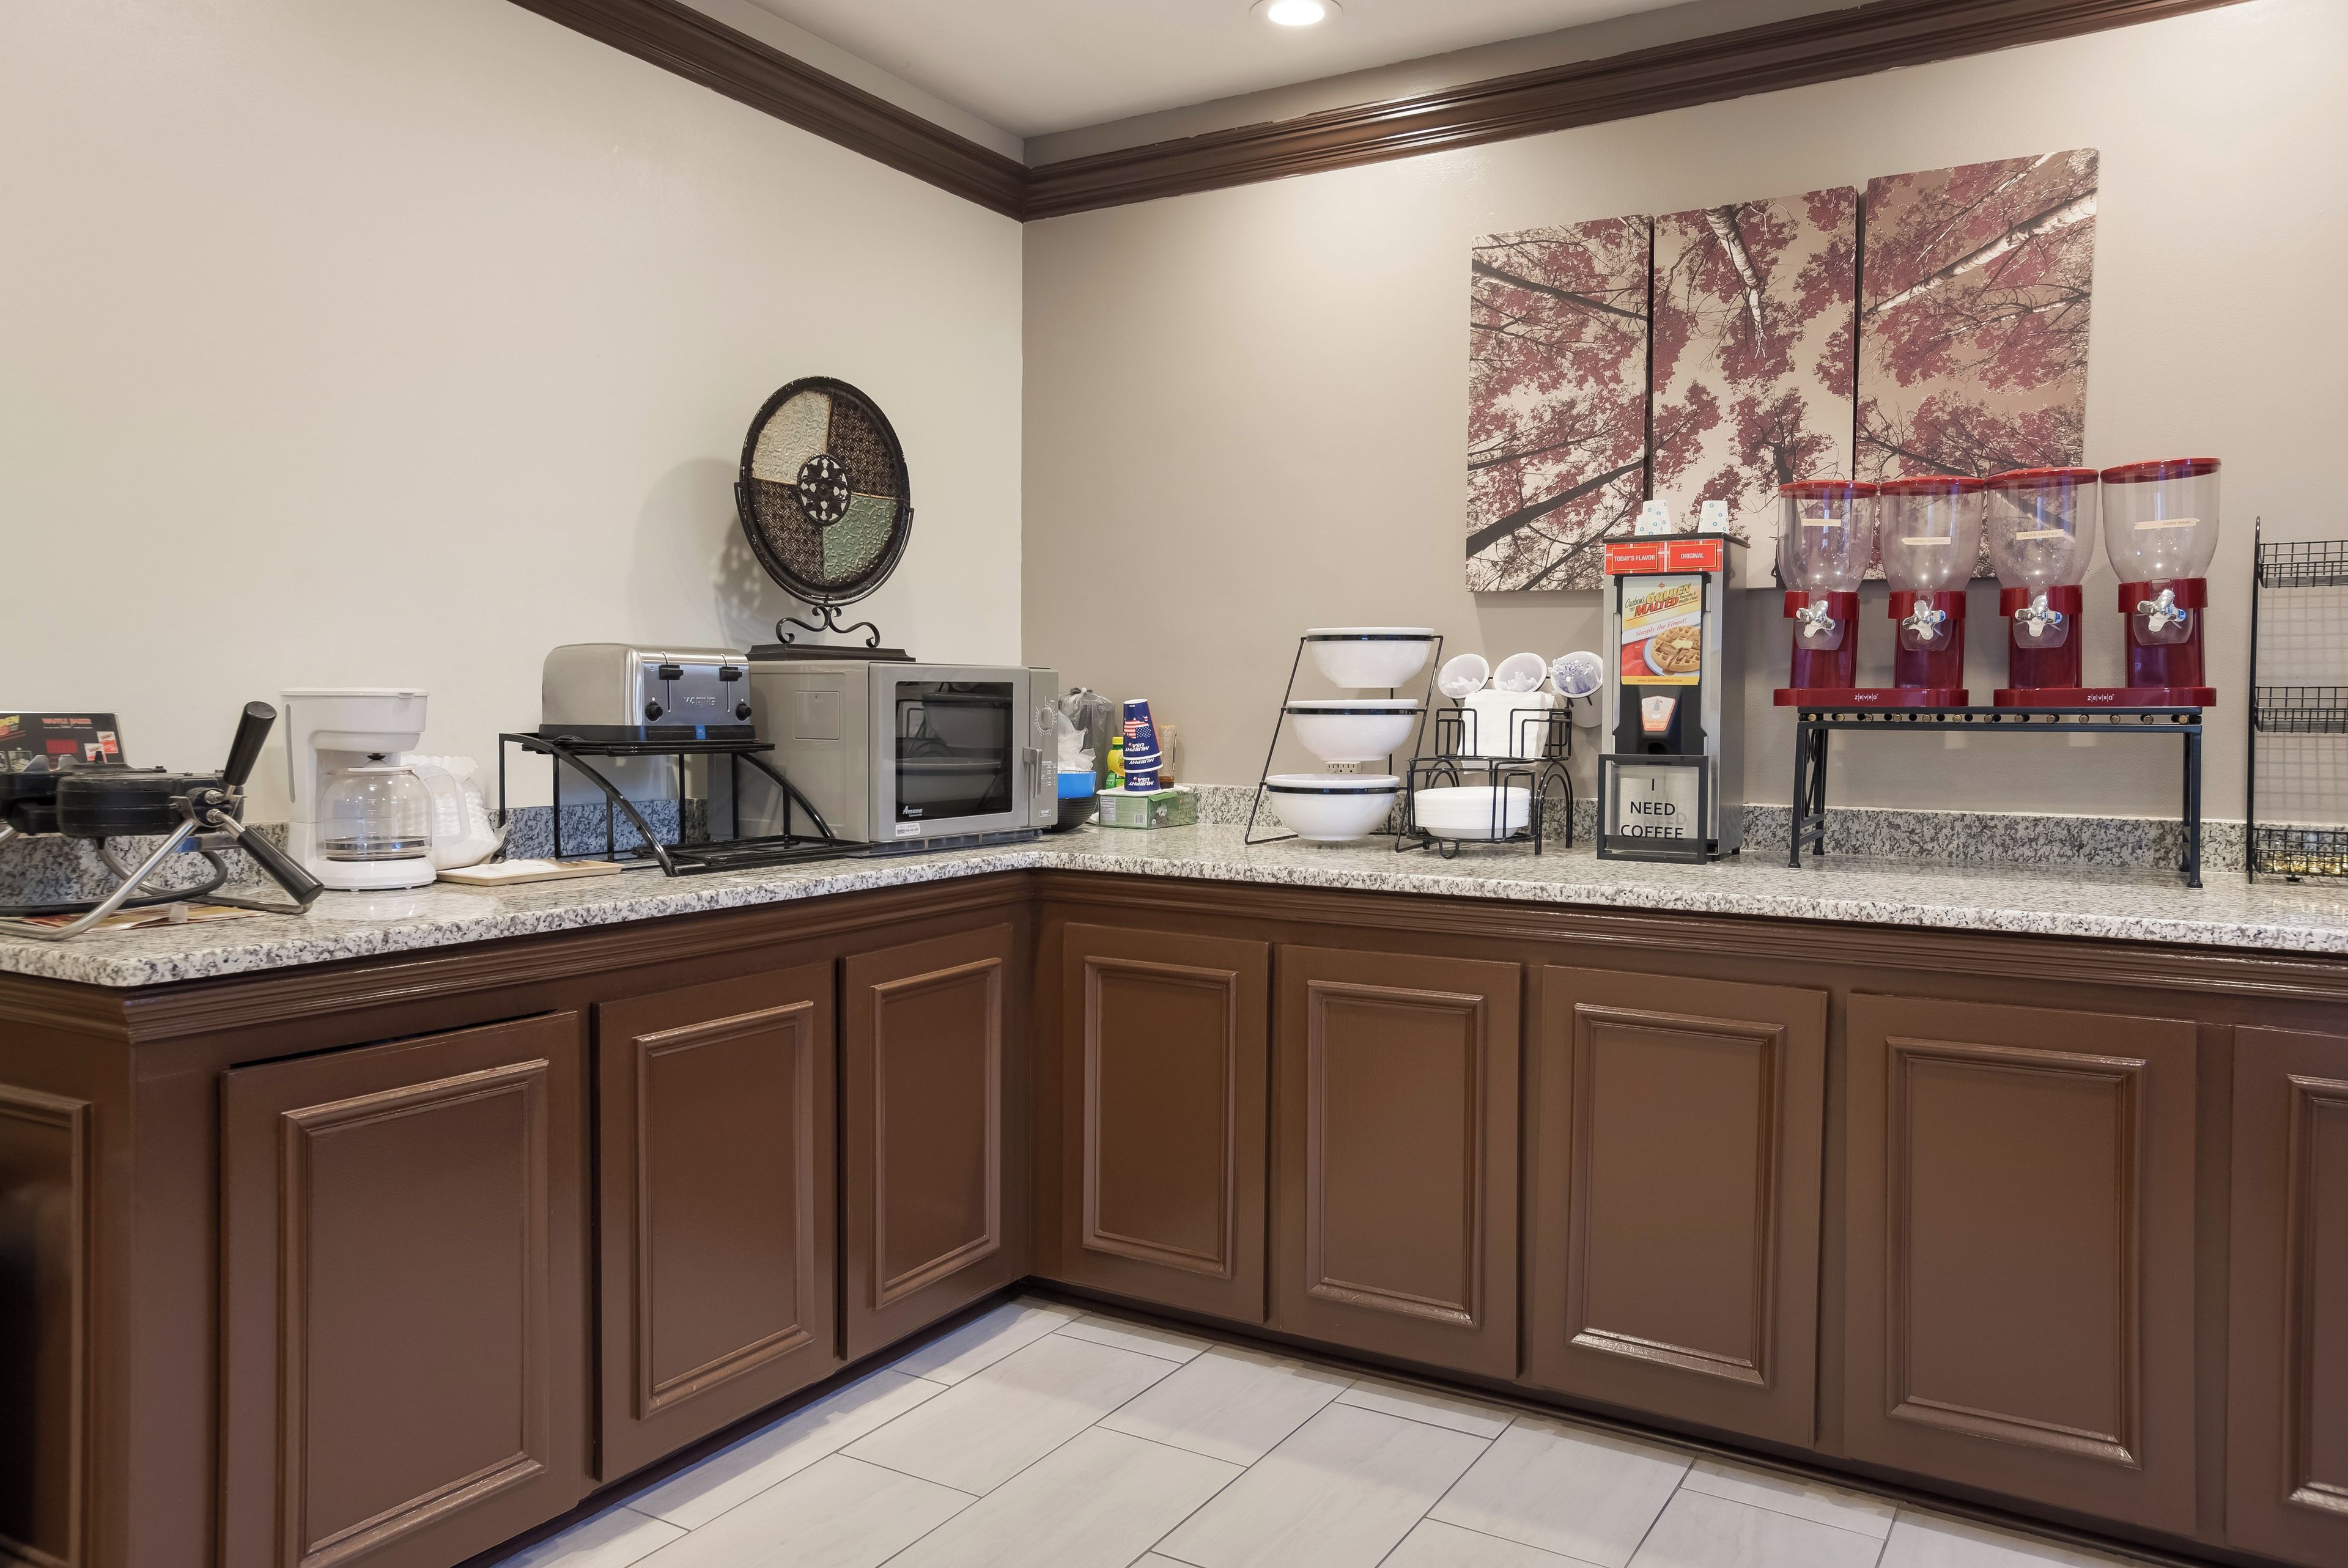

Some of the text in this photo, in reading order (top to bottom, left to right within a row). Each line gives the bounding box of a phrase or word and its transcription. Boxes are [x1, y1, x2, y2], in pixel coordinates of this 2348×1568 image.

[1646, 583, 1691, 603] GOLDEN
[1634, 596, 1679, 617] MALTED
[1636, 627, 1655, 636] Simply
[1667, 617, 1688, 628] Finest!
[1652, 778, 1655, 791] I
[903, 806, 923, 815] Amana
[1630, 801, 1675, 815] NEED
[1620, 824, 1683, 840] COFFEE
